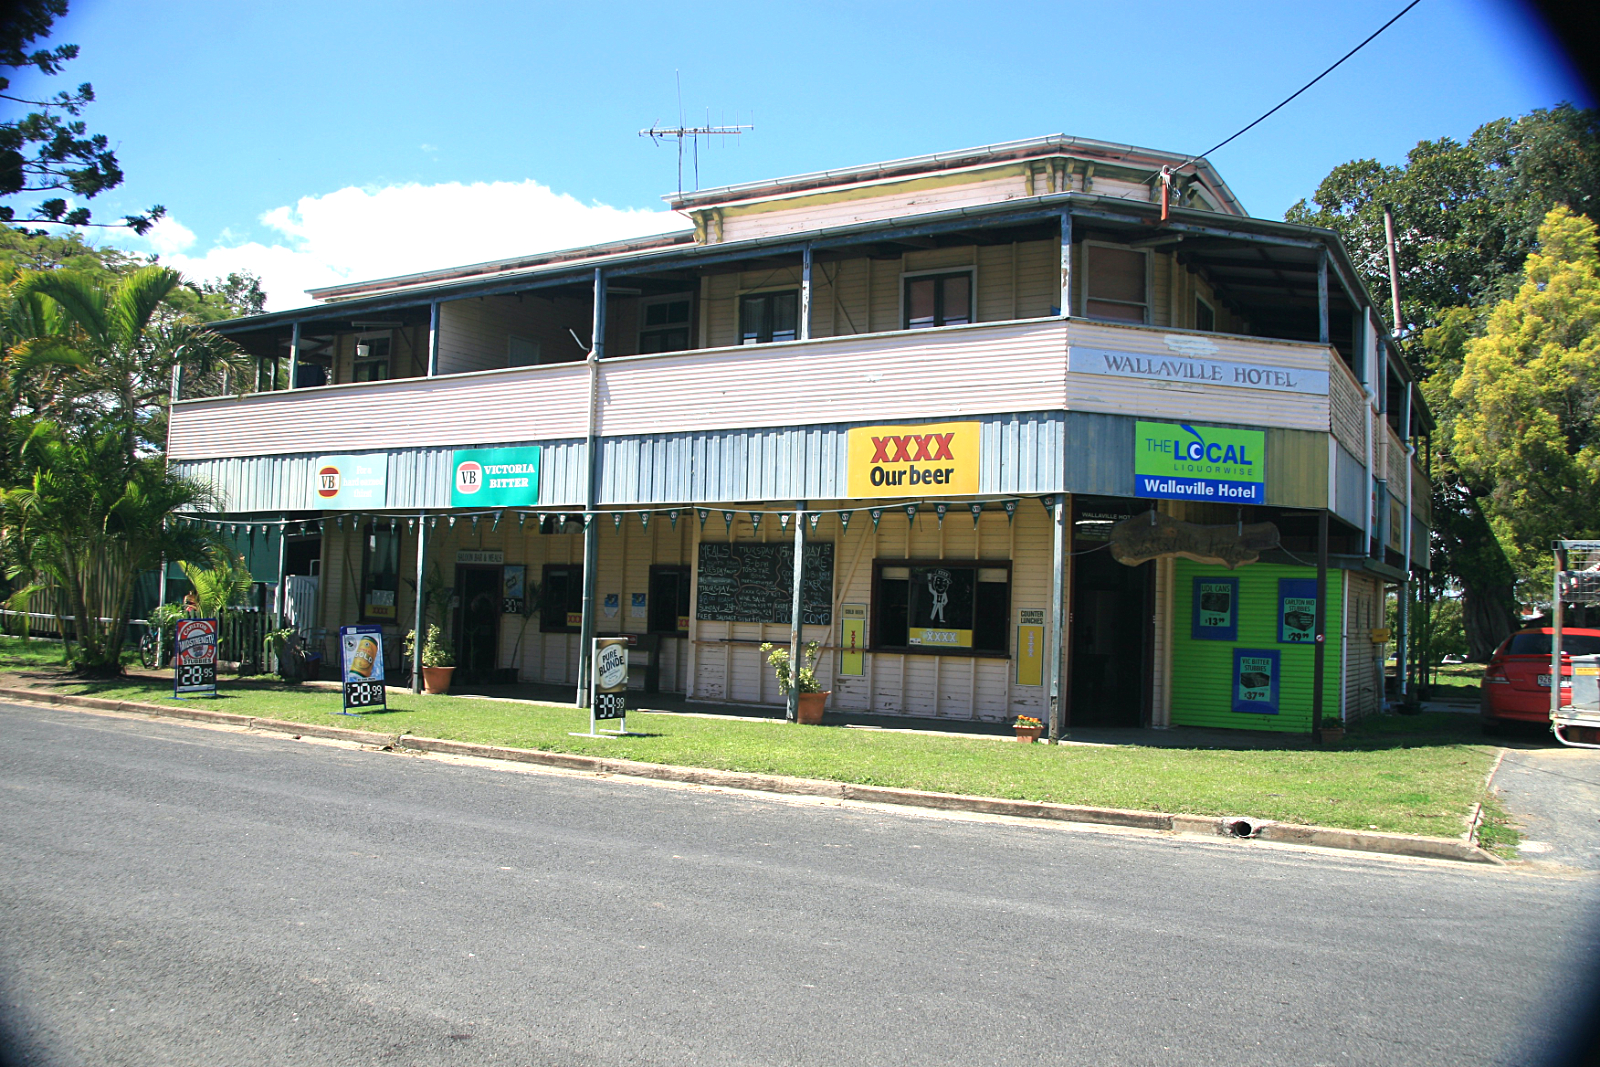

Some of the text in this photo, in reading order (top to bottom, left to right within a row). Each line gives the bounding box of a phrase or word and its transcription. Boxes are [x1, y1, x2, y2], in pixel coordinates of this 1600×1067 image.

[1103, 354, 1298, 388] WALLAVILLE HOTEL
[869, 432, 955, 464] XXXX
[1145, 438, 1253, 466] THE LOCAL
[483, 463, 536, 475] VICTORIA
[869, 464, 955, 487] Our beer
[1173, 463, 1253, 477] LIQUORWISE
[321, 475, 335, 489] VB
[461, 470, 477, 485] VB
[489, 478, 529, 489] BITTER
[1143, 478, 1256, 499] Wallaville Hotel
[1081, 511, 1118, 520] WALLAVILLE
[457, 553, 473, 562] SALOON
[474, 553, 483, 562] BAR
[488, 553, 502, 562] MEALS
[700, 544, 730, 560] MEALS
[739, 546, 775, 556] THURSDAY
[1201, 584, 1214, 592] UDL
[1020, 610, 1044, 618] COUNTER
[1020, 617, 1043, 625] LUNCHES
[183, 623, 208, 636] CARLTON
[926, 631, 957, 643] XXXX
[184, 657, 212, 665] STUBBIES
[354, 651, 373, 664] GOLD
[602, 649, 618, 663] PURE
[598, 655, 625, 677] BLONDE
